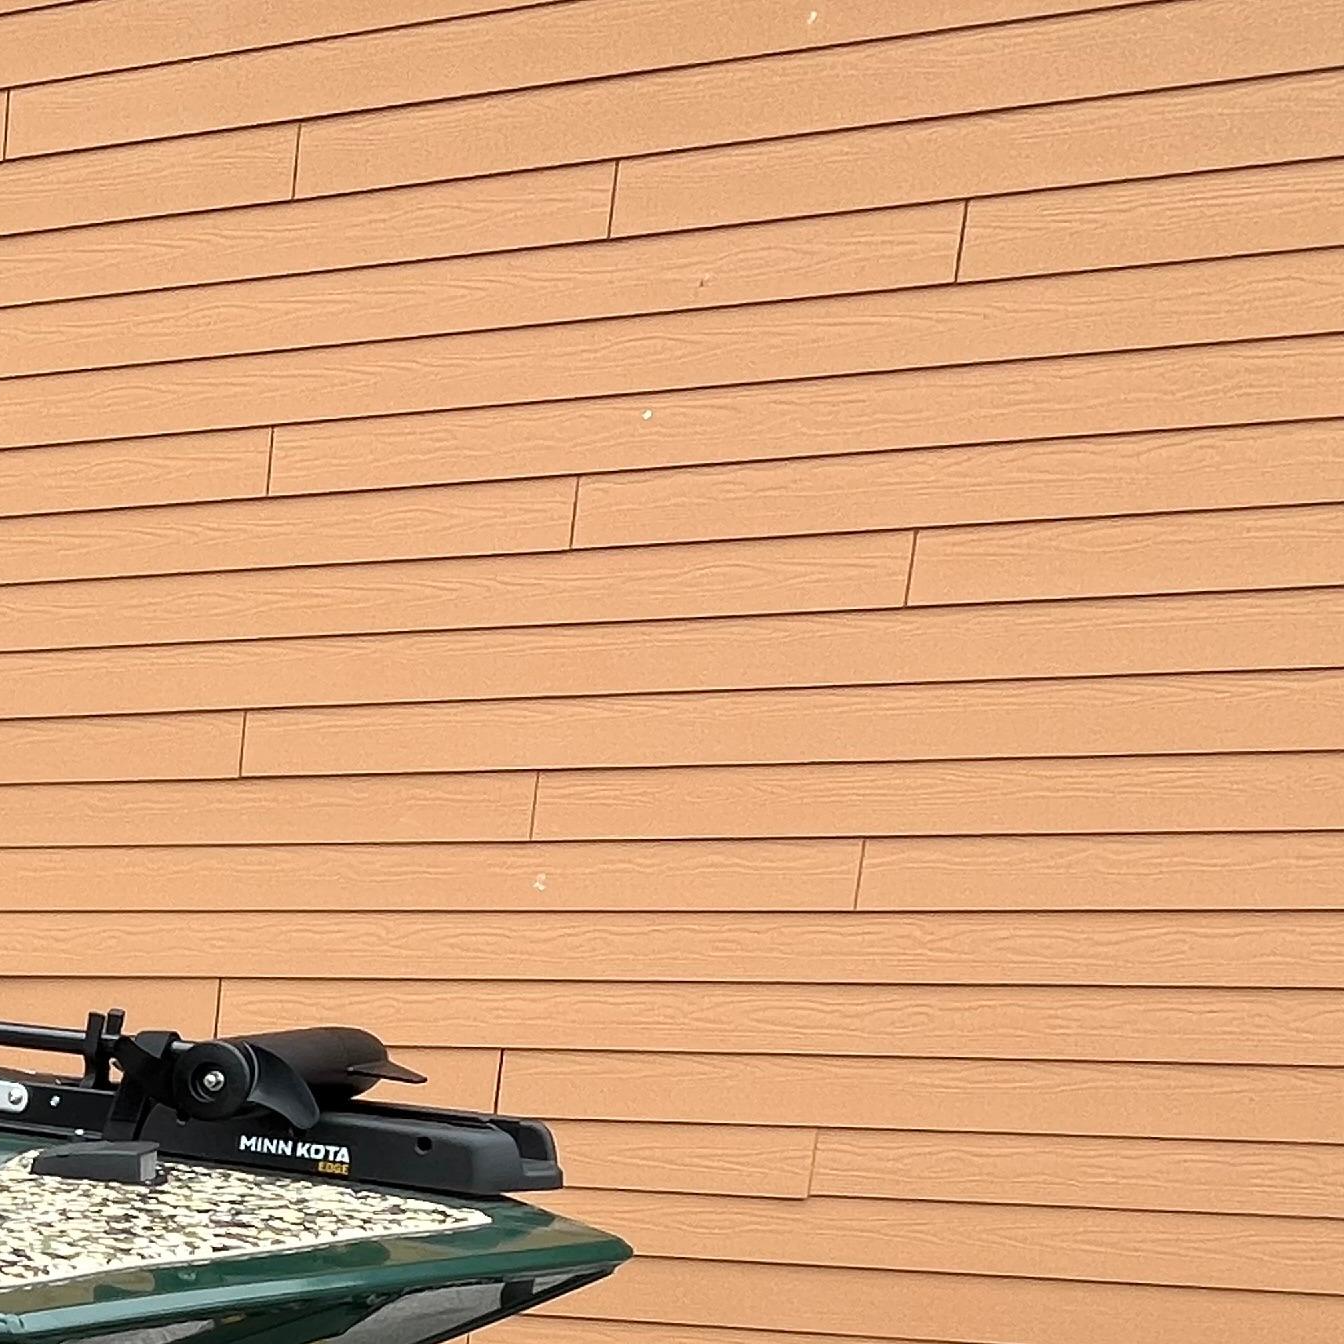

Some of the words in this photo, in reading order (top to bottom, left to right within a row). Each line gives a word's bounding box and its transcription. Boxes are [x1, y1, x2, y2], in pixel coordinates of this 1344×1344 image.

[239, 1134, 292, 1156] MINN
[296, 1141, 350, 1163] KOTA
[318, 1161, 349, 1175] EDGE
